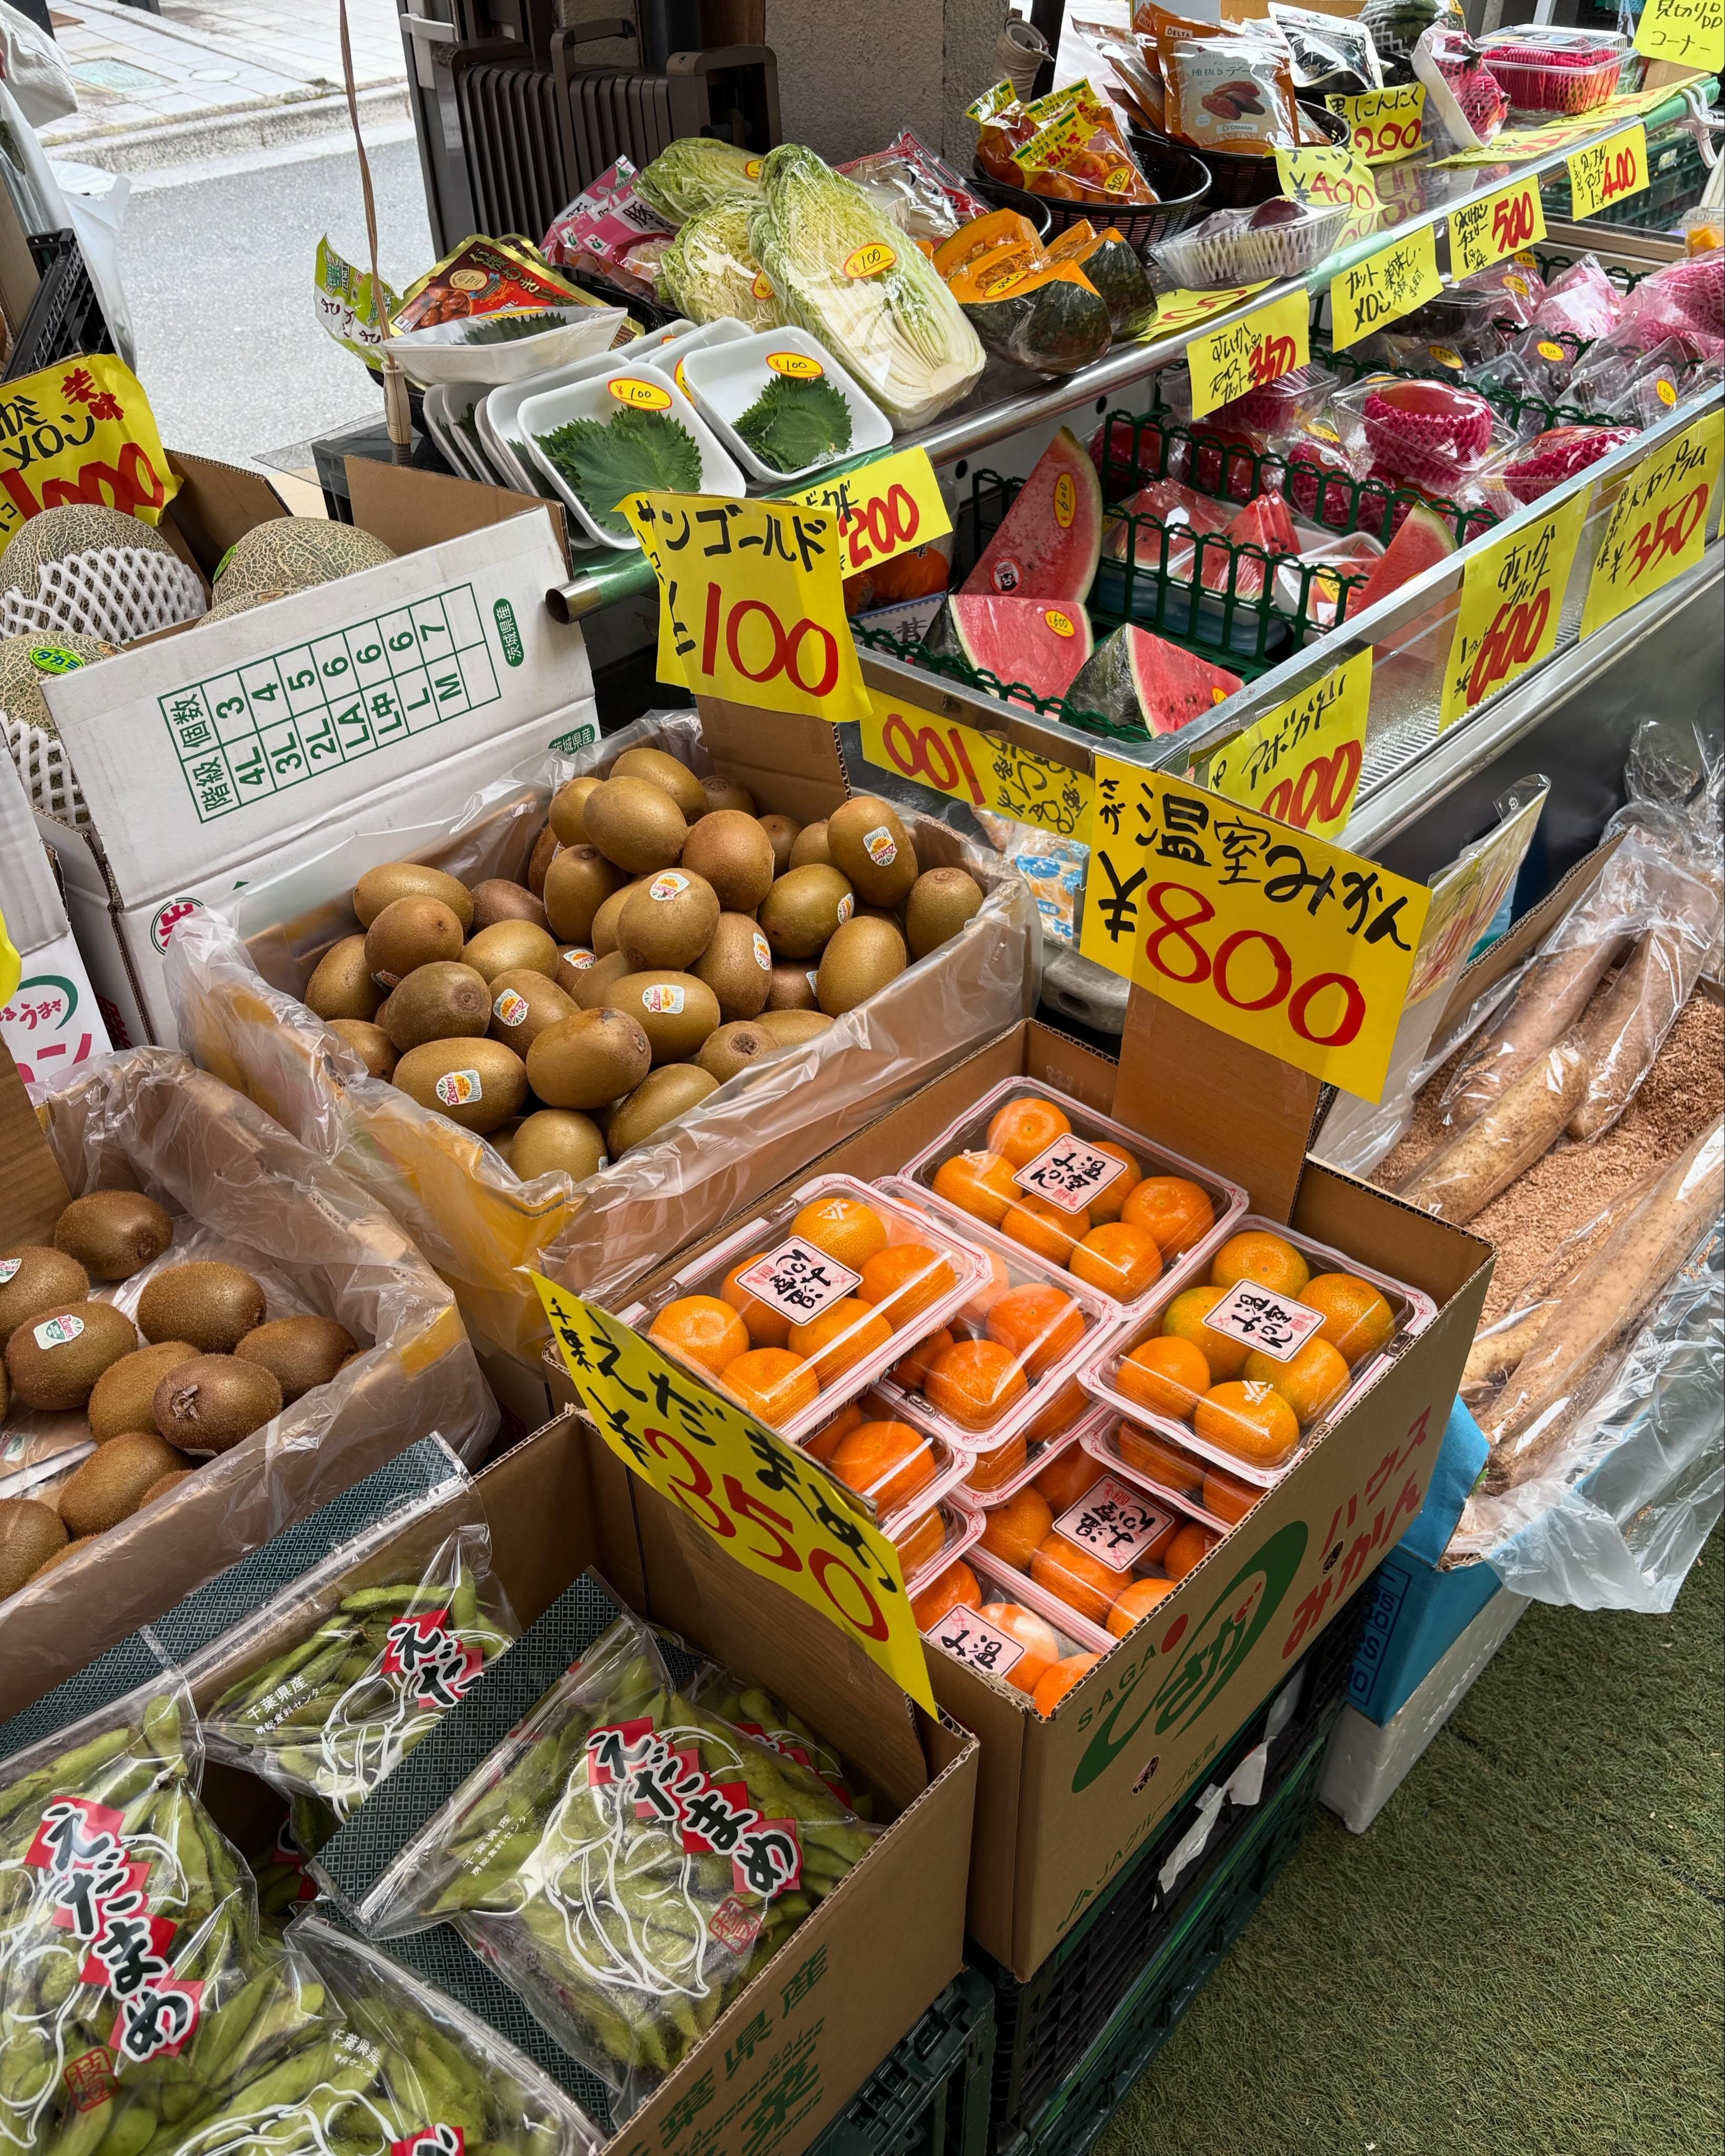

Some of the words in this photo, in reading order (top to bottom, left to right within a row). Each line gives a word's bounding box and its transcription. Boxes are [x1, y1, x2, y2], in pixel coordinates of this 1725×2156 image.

[1166, 29, 1191, 38] DELTA
[1651, 31, 1711, 56] コーナー
[1345, 263, 1379, 300] カット
[1354, 290, 1392, 333] メロン
[773, 358, 807, 372] ¥100
[616, 384, 652, 400] ¥100
[0, 395, 48, 440] カミ
[2, 415, 95, 471] メロン
[635, 500, 827, 573] サンゴールド
[389, 631, 414, 652] 6
[420, 624, 445, 642] 7
[495, 604, 523, 663] 茨城県産
[37, 651, 81, 670] タカミ
[322, 656, 349, 678] 6
[356, 643, 382, 665] 6
[251, 682, 278, 702] 4
[287, 670, 315, 693] 5
[406, 687, 431, 712] L
[434, 673, 464, 703] M
[171, 693, 213, 748] 個数
[216, 696, 245, 720] 3
[337, 703, 370, 748] LA
[371, 691, 404, 736] L中
[275, 731, 303, 774] 3L
[311, 716, 337, 760] 2L
[200, 756, 230, 813] 階級
[237, 745, 267, 786] 4L
[873, 843, 896, 862] Zespri
[1135, 782, 1413, 952] 温室みかん
[507, 999, 528, 1024] Zespri
[650, 986, 662, 1012] Zespri
[446, 1073, 461, 1105] Zespri
[1029, 1152, 1077, 1190] みかん
[776, 1249, 831, 1287] みかん
[57, 1316, 75, 1340] Zespri
[1231, 1313, 1293, 1349] みかん
[585, 1309, 899, 1593] えだまめ
[1320, 1404, 1433, 1560] ハウス
[1106, 1505, 1156, 1549] みかん
[1281, 1487, 1421, 1660] みかん
[247, 1674, 310, 1721] 千葉県産
[1077, 1643, 1156, 1733] SAGA
[589, 1733, 796, 1893] えだまめ
[462, 1812, 515, 1870] 千葉県産
[44, 1806, 190, 2058] えだまめ
[705, 2042, 822, 2156] 菜
